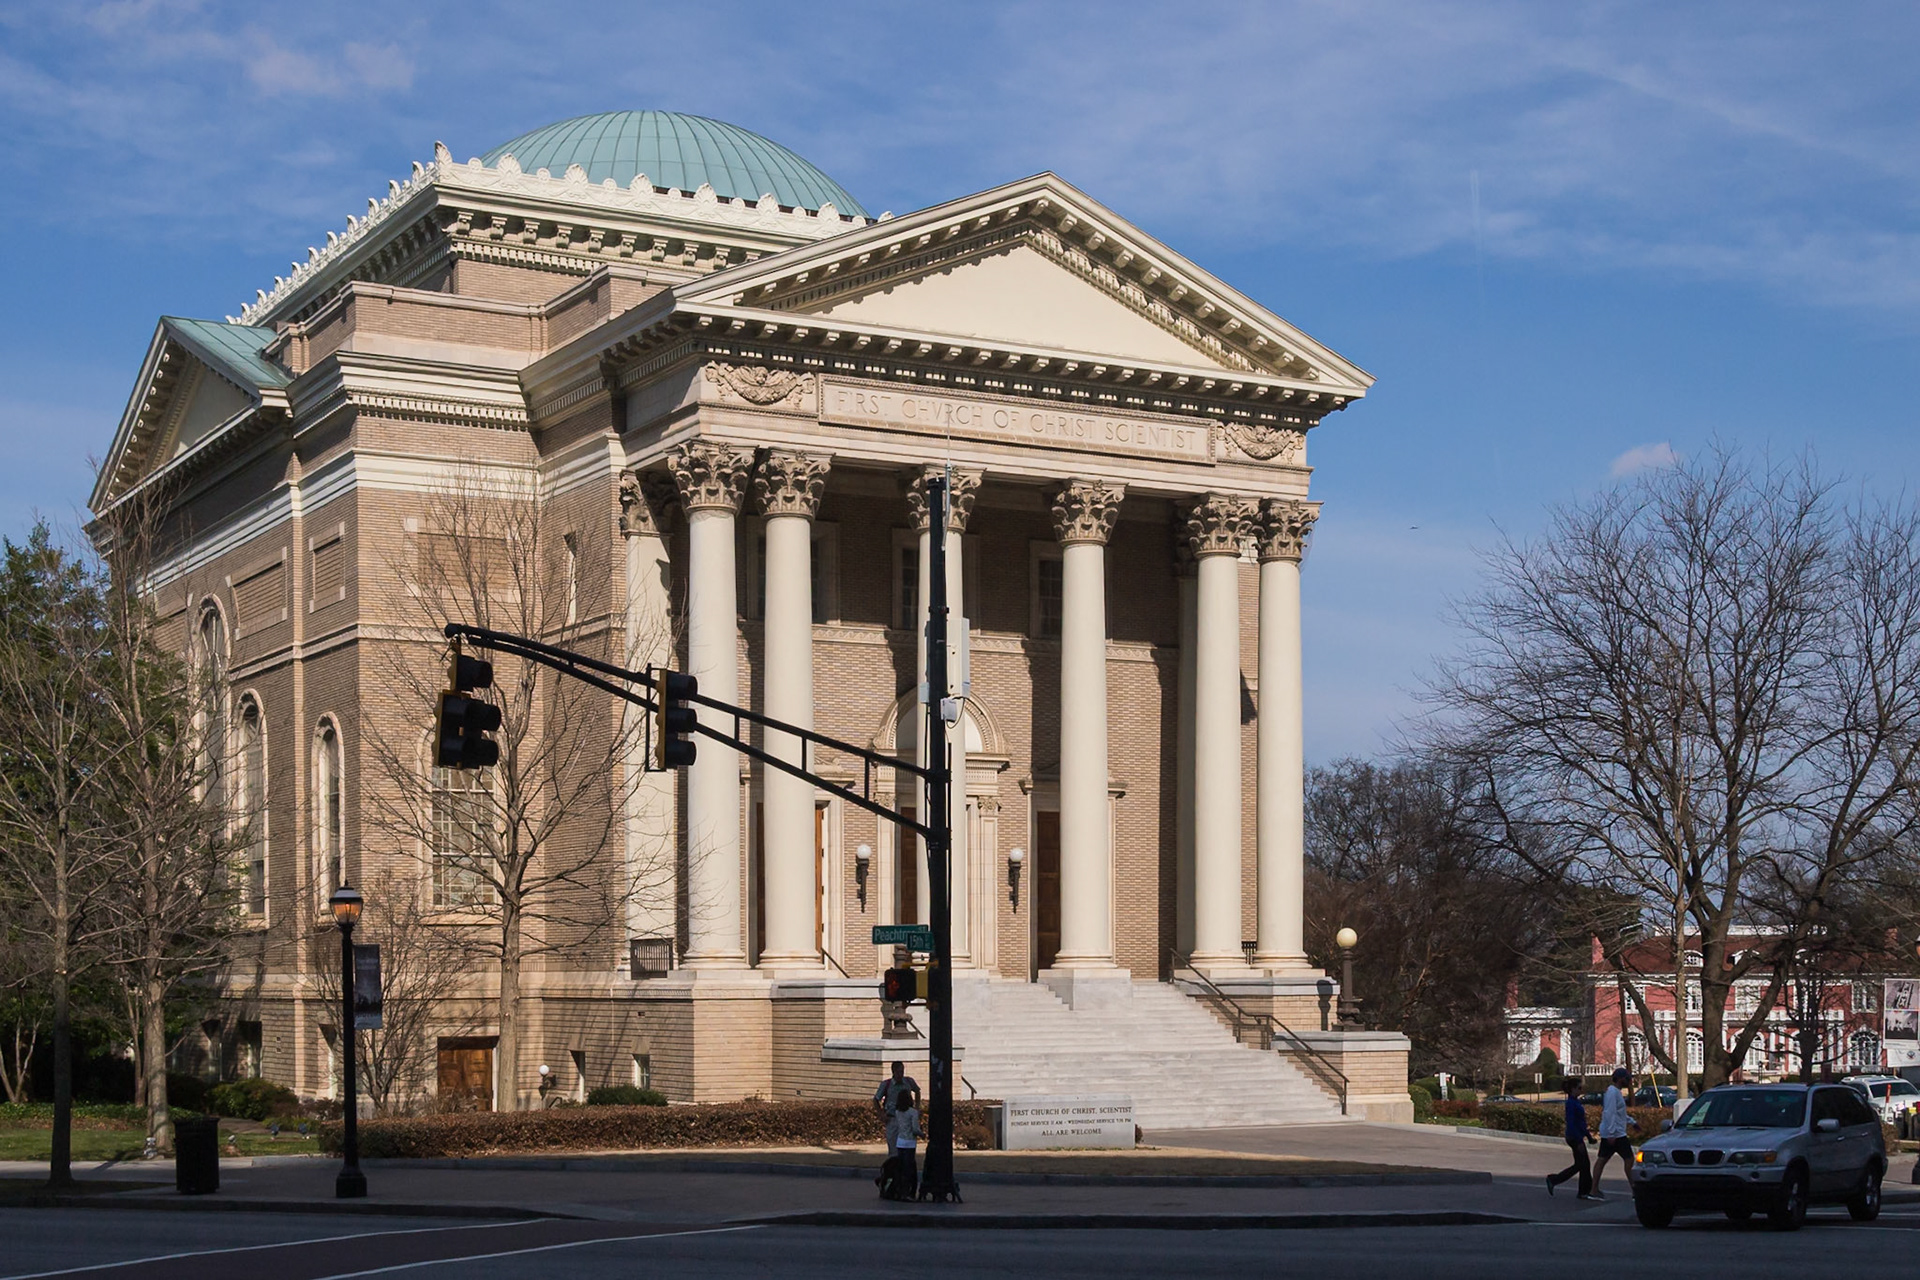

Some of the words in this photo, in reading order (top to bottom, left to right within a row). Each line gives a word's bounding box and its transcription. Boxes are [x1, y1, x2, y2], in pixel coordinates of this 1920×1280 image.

[838, 390, 891, 415] FIRST
[993, 409, 1019, 431] OF
[1030, 413, 1095, 440] CHRIST
[1104, 422, 1196, 451] SCIENTIST
[874, 928, 915, 941] Peachtr
[1010, 1109, 1029, 1117] FIRST
[1030, 1108, 1059, 1116] CHURCH
[1099, 1106, 1132, 1114] SCIENTIST
